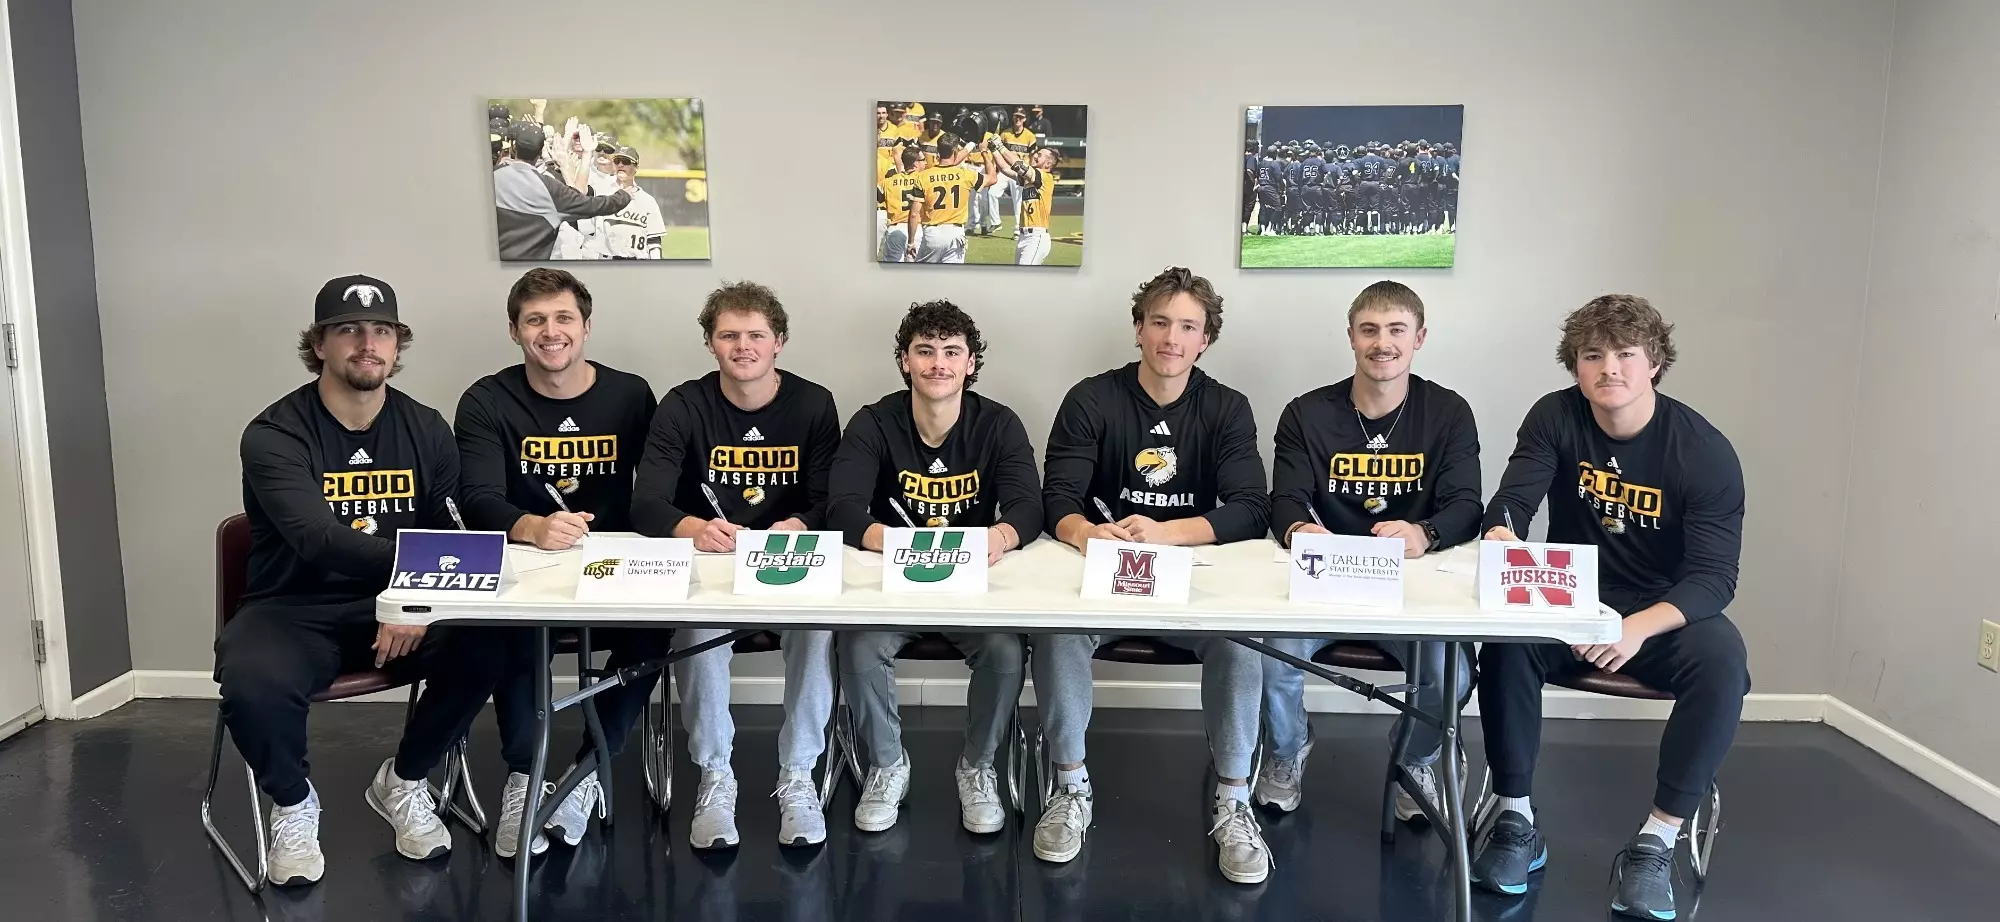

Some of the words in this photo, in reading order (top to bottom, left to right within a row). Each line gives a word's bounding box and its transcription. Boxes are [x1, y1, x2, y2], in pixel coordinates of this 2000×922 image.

[1364, 161, 1380, 175] 34
[929, 173, 961, 183] BIRDS
[933, 185, 960, 210] 21
[1027, 203, 1034, 215] 6
[630, 234, 646, 251] 18
[524, 439, 614, 460] CLOUD
[713, 449, 796, 469] CLOUD
[1333, 457, 1421, 478] CLOUD
[520, 460, 617, 477] BASEBALL
[708, 469, 799, 486] BASEBALL
[323, 474, 411, 497] CLOUD
[901, 473, 977, 500] CLOUD
[1328, 479, 1424, 496] BASEBALL
[746, 550, 826, 569] Upstate
[893, 548, 971, 567] Upstate
[1114, 548, 1158, 580] M
[1330, 553, 1400, 569] TARLETON
[627, 568, 677, 576] UNIVERSITY
[1329, 565, 1350, 573] STATE
[1352, 567, 1400, 576] UNIVERSITY
[1500, 569, 1578, 589] HUSKERS
[393, 571, 500, 589] K-STATE
